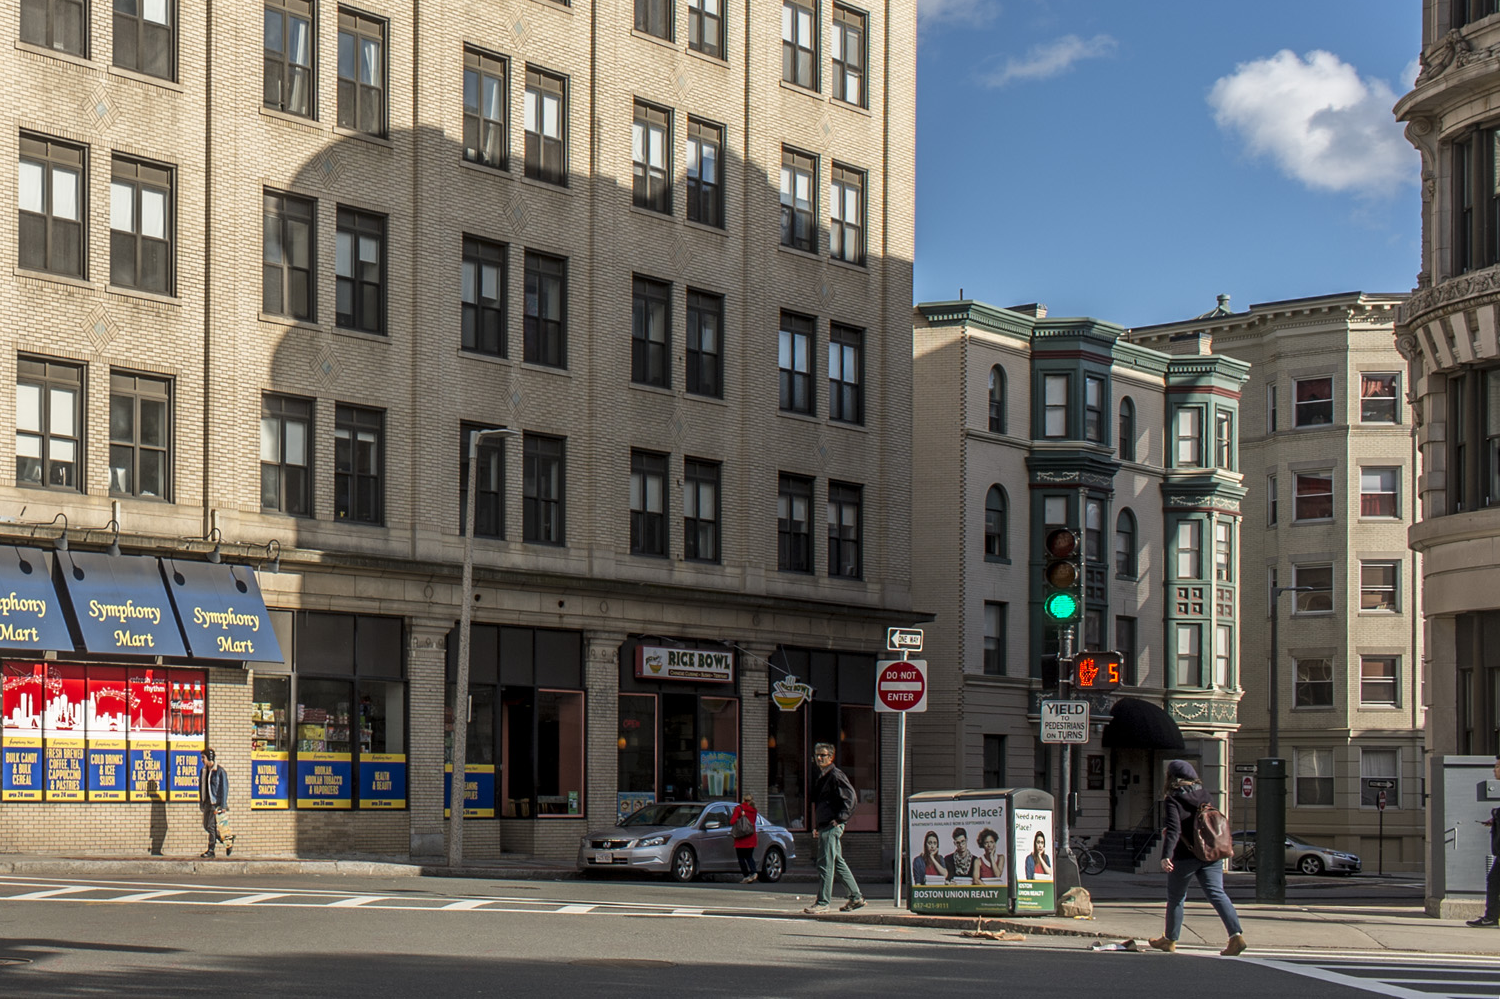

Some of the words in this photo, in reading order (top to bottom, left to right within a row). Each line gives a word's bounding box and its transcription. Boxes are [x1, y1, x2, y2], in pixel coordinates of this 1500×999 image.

[88, 600, 161, 625] Symphony
[193, 607, 260, 632] Symphony
[114, 629, 155, 648] Mart
[898, 635, 908, 643] ONE
[217, 636, 255, 654] Mart
[667, 650, 695, 668] RICE
[697, 652, 731, 670] BOWL
[886, 671, 898, 680] DO
[900, 671, 917, 680] NOT
[1108, 663, 1119, 683] 5
[144, 685, 166, 693] rhythm
[887, 693, 914, 701] ENTER
[1046, 704, 1085, 715] YIELD
[1044, 722, 1085, 730] PEDESTRIANS
[1057, 730, 1083, 740] TURNS
[5, 752, 20, 763] BULK
[20, 752, 38, 764] CANDY
[46, 748, 62, 759] FRESH
[63, 748, 84, 759] BREWED
[143, 750, 153, 761] ICE,
[49, 759, 70, 769] COFFEE,
[70, 759, 80, 769] TEA,
[90, 754, 104, 765] COLD
[105, 754, 123, 765] DRINKS
[175, 755, 185, 765] PET
[185, 755, 198, 765] FOOD
[12, 764, 18, 774] &
[18, 764, 32, 774] BULK
[99, 765, 104, 775] &
[104, 765, 116, 775] ICEE
[134, 760, 144, 770] ICE
[144, 760, 161, 771] CREAM
[257, 765, 277, 775] NATURAL
[48, 769, 82, 780] CAPPUCCINO
[132, 771, 137, 781] &
[137, 771, 147, 781] ICE
[147, 771, 163, 781] CREAM
[176, 766, 182, 776] &
[182, 766, 197, 776] PAPER
[374, 771, 390, 781] HEALTH
[12, 774, 32, 785] CEREAL
[99, 775, 116, 786] SLUSH
[174, 776, 199, 786] PRODUCTS
[255, 775, 259, 785] &
[260, 775, 279, 785] ORGANIC
[50, 780, 55, 790] &
[56, 780, 80, 790] PASTRIES
[258, 785, 276, 794] SNACKS
[376, 781, 392, 791] BEAUTY
[911, 808, 937, 820] Need
[939, 810, 945, 819] a
[947, 809, 969, 819] new
[971, 806, 1003, 818] Place?
[1016, 812, 1030, 820] Need
[1016, 823, 1032, 831] Place?
[913, 890, 943, 899] BOSTON
[944, 890, 970, 898] UNION
[970, 890, 999, 899] REALTY
